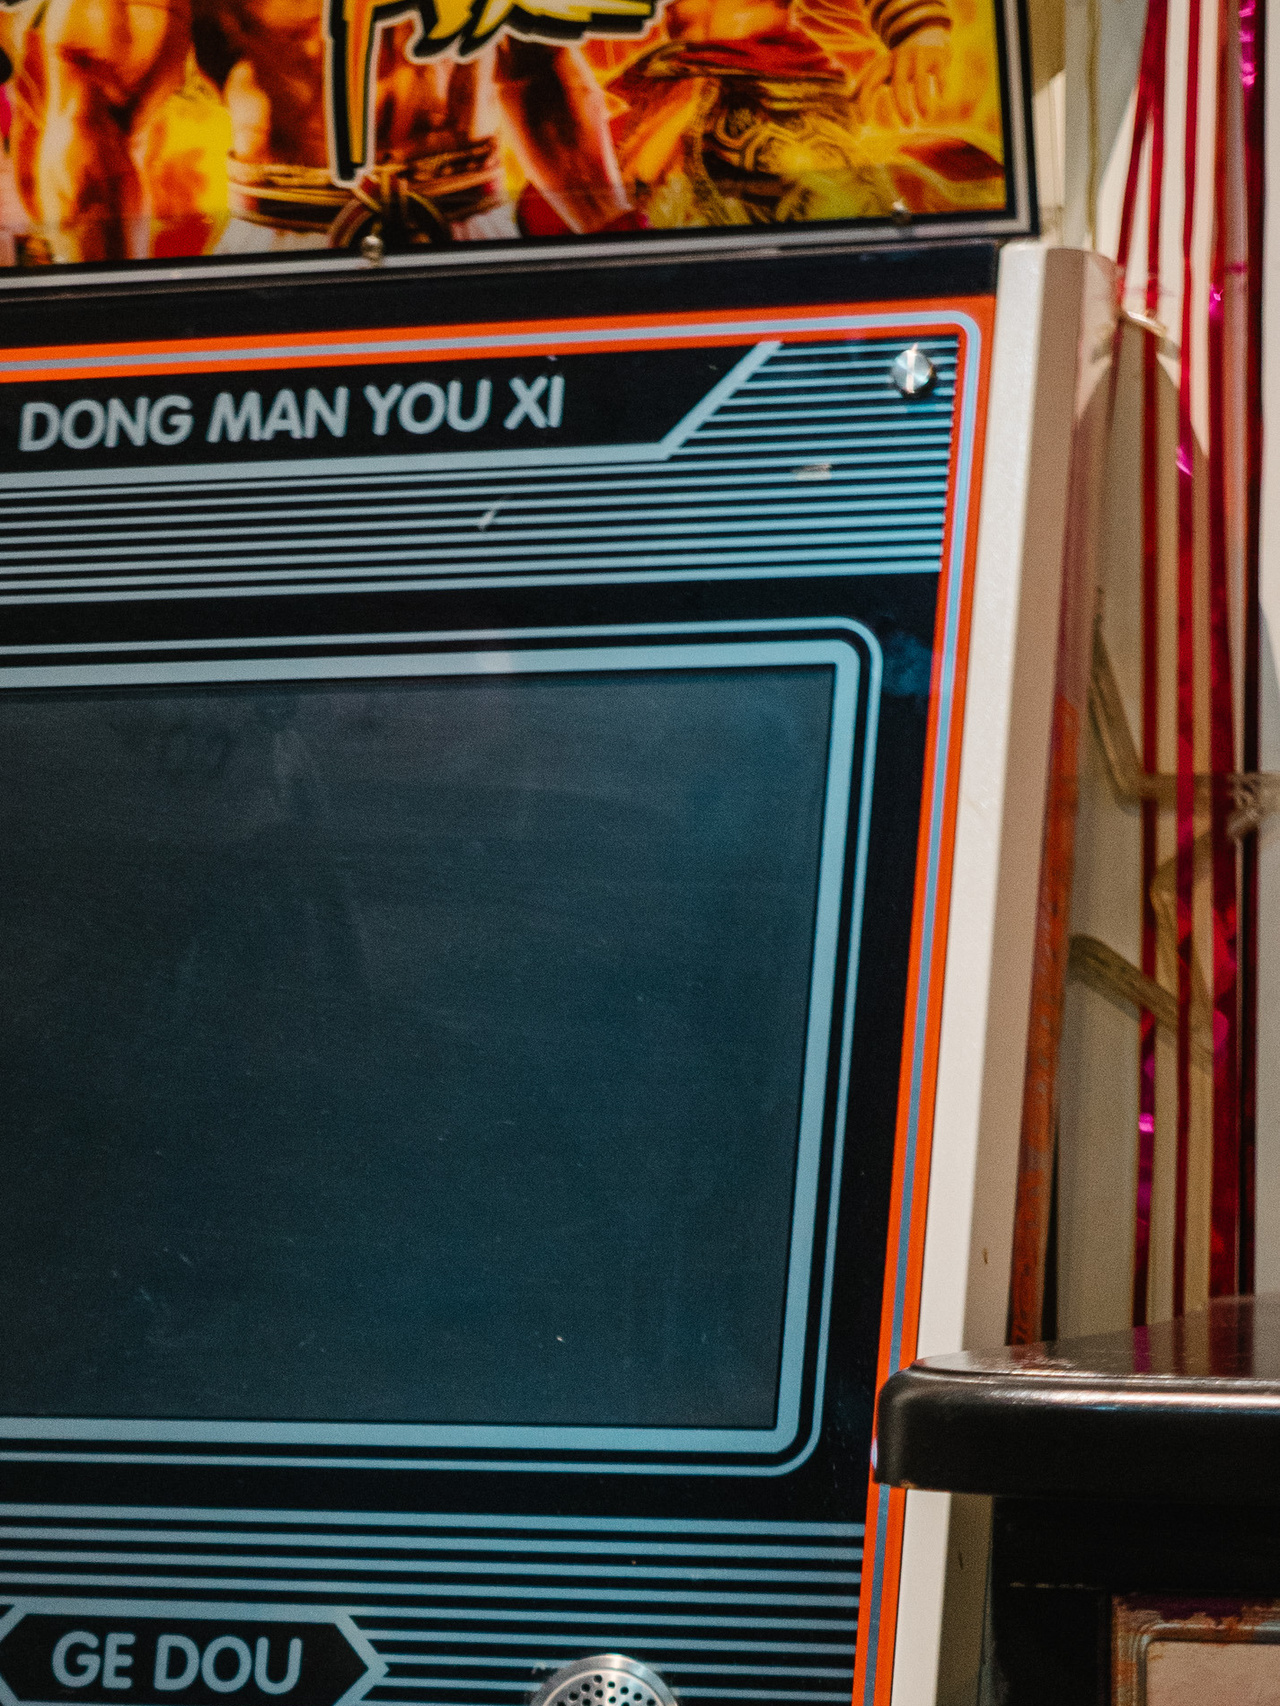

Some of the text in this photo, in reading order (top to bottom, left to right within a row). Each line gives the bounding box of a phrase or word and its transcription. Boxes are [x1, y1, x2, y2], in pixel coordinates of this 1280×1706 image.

[20, 376, 564, 451] DONG MAN YOU XI
[53, 1631, 302, 1694] GE DOU
